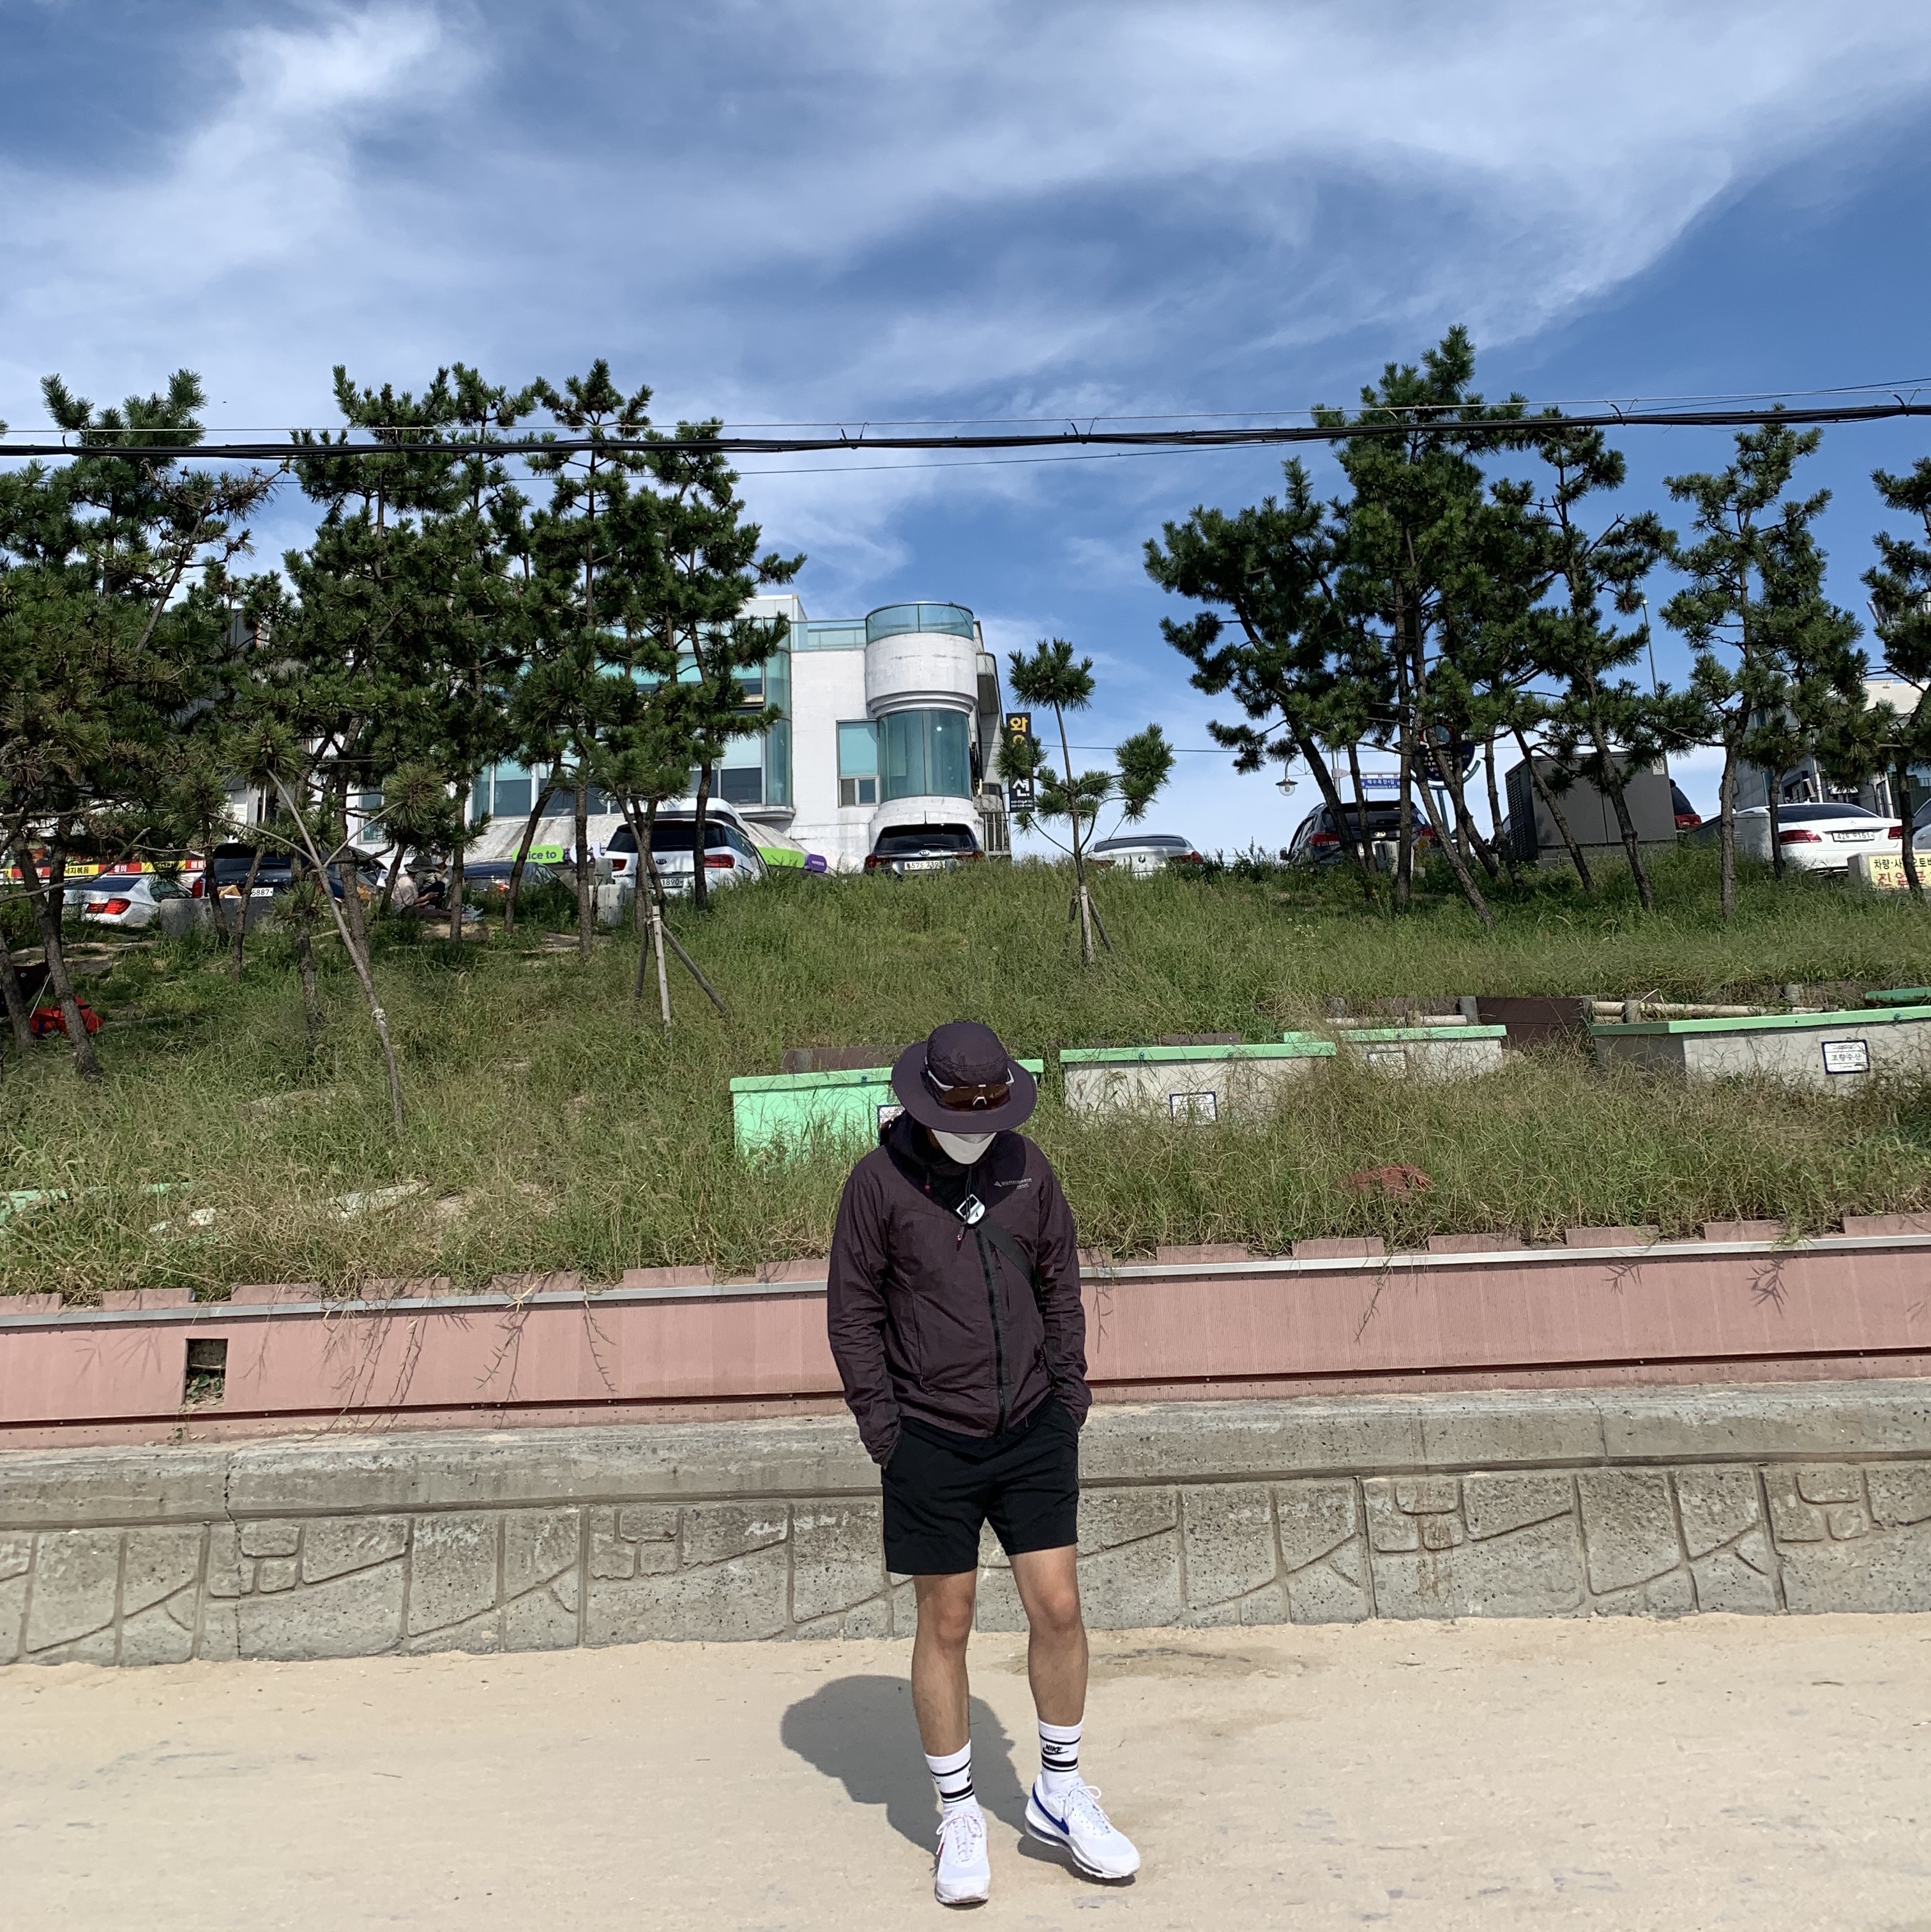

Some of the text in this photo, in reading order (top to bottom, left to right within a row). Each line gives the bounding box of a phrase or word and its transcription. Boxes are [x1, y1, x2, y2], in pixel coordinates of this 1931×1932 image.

[528, 850, 556, 860] ice to
[1045, 1744, 1063, 1753] NIKE
